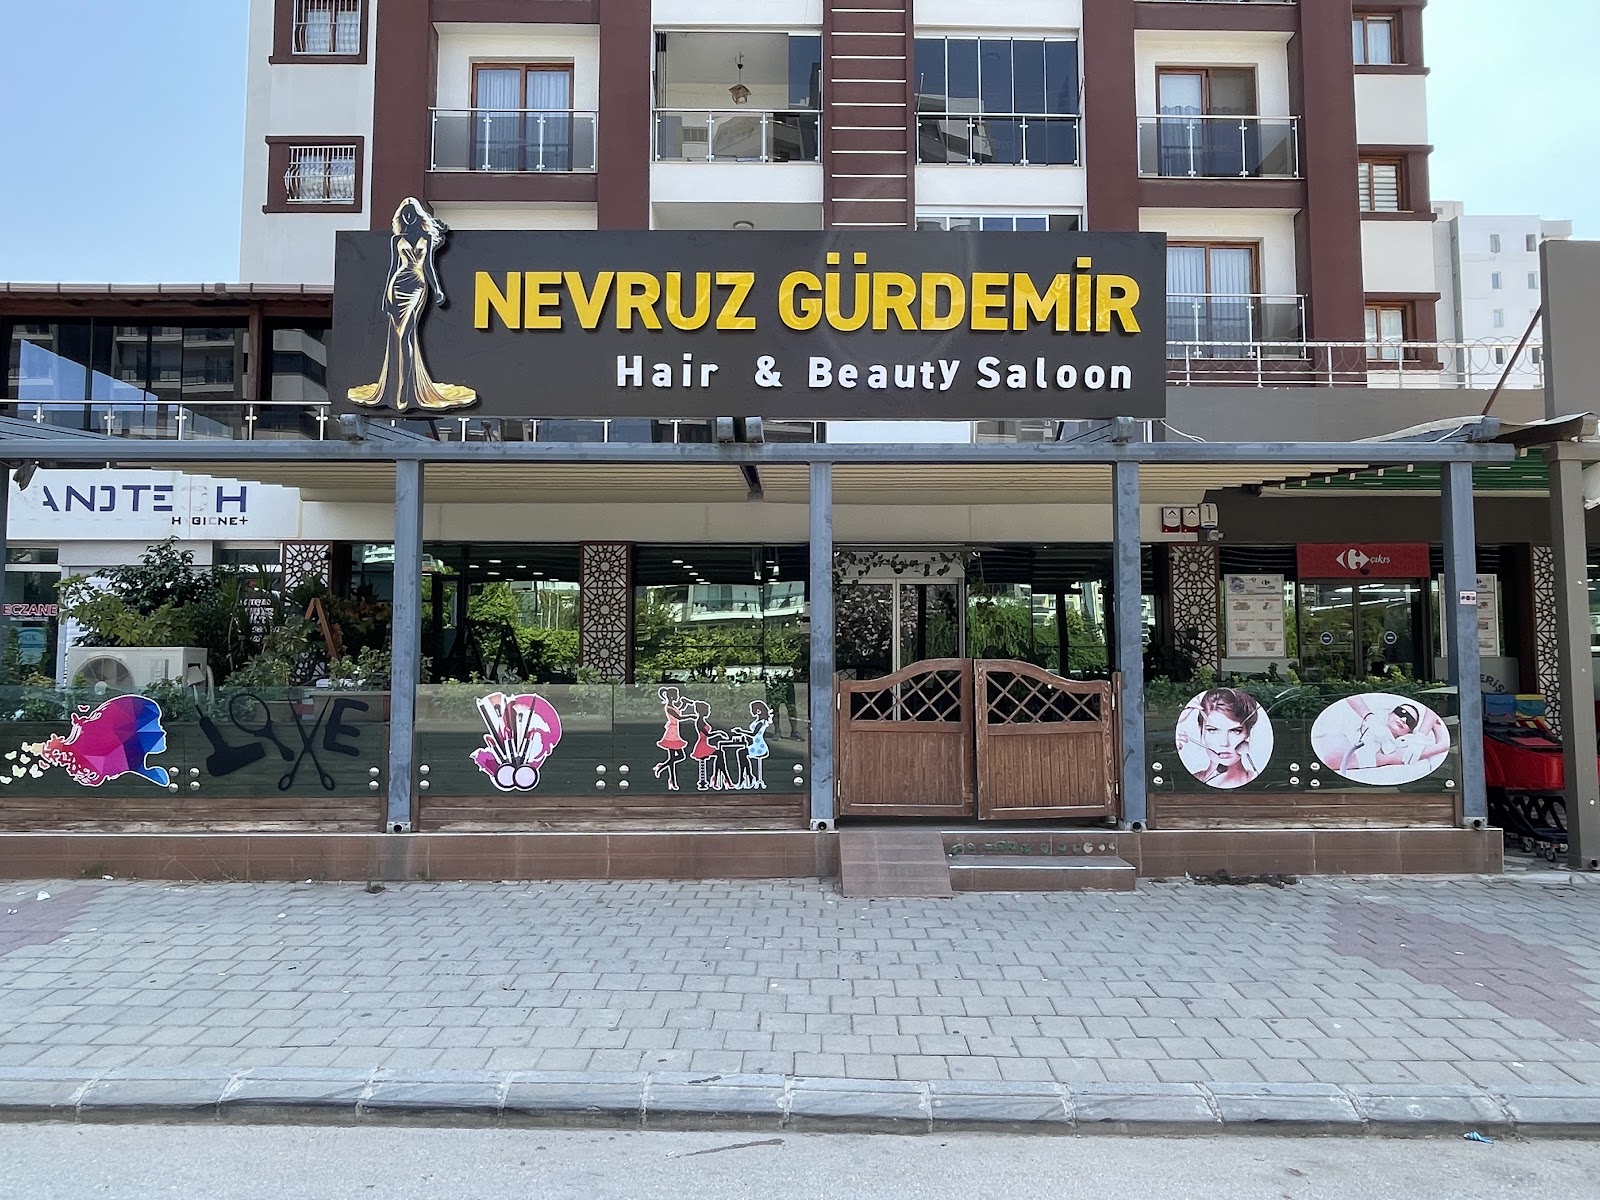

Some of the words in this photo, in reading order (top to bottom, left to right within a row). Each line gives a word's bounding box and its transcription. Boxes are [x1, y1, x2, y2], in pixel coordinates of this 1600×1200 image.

[473, 270, 757, 331] NEVRUZ
[778, 251, 1142, 333] GÜRDEMİR
[616, 353, 719, 388] Hair
[754, 355, 783, 388] &
[808, 356, 960, 391] Beauty
[976, 356, 1132, 390] Saloon
[2, 603, 58, 616] ECZANE
